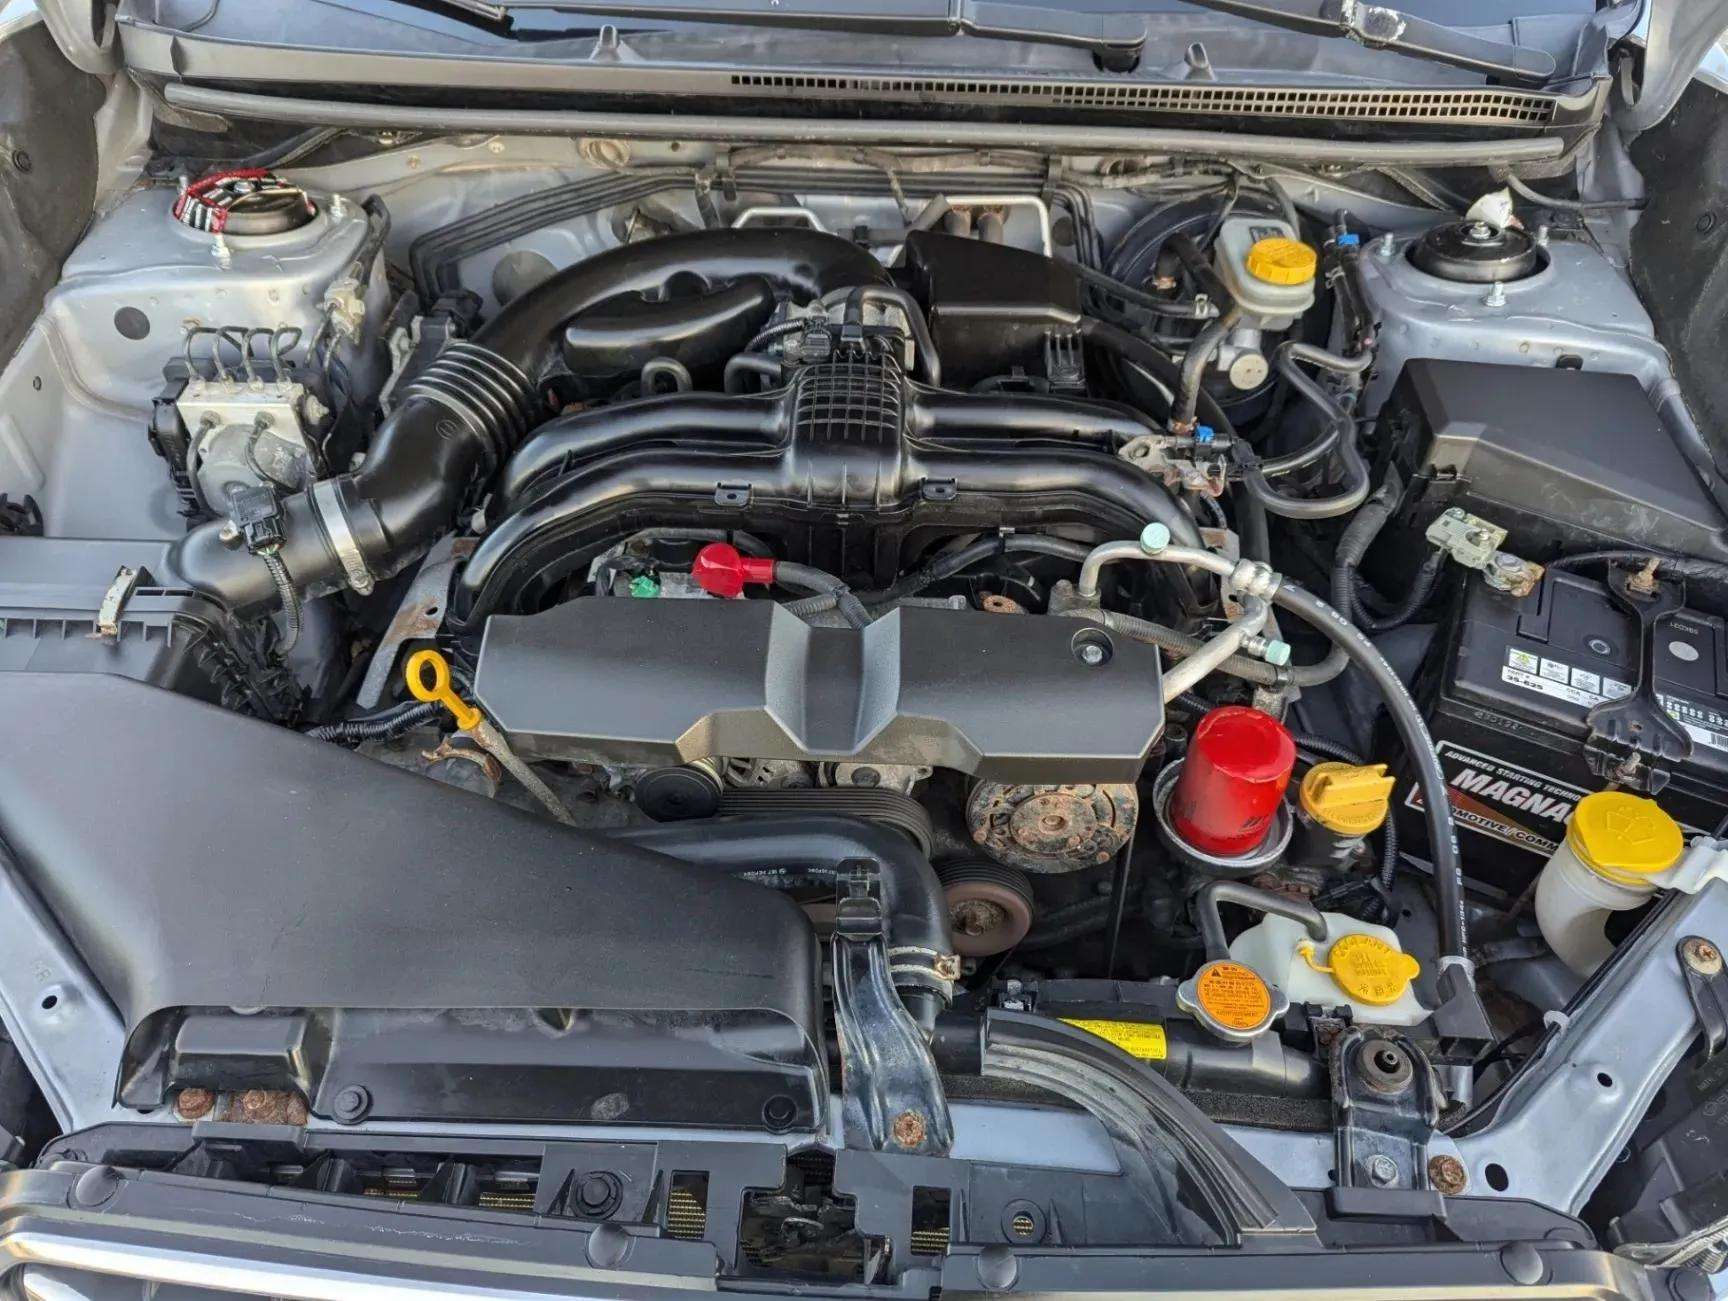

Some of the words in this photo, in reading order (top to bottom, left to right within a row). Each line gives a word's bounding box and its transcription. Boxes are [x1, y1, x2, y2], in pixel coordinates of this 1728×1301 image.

[1444, 750, 1496, 772] ADVANCED
[1495, 767, 1543, 788] STARTING
[1450, 768, 1574, 824] MAGNA
